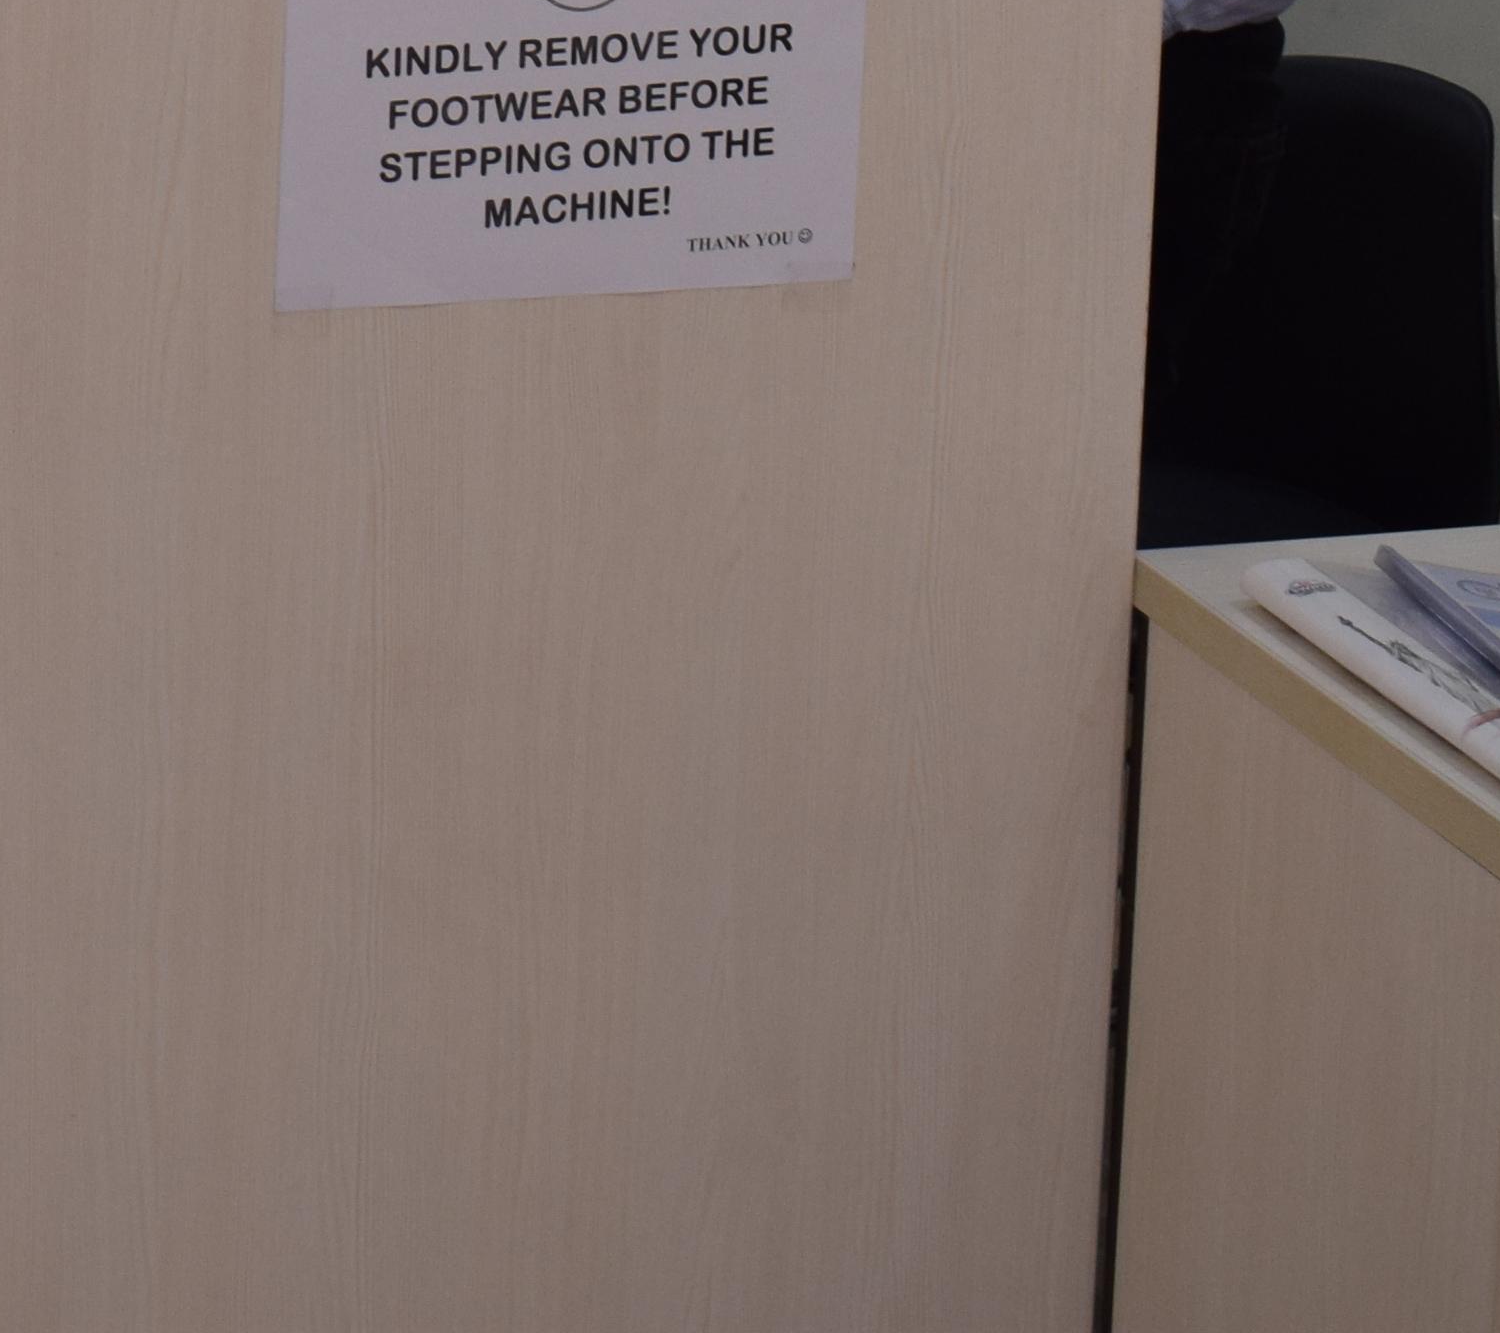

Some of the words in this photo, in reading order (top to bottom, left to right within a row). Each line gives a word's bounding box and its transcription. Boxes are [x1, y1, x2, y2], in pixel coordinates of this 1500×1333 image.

[365, 40, 508, 79] KINDLY
[518, 29, 679, 69] REMOVE
[689, 21, 795, 56] YOUR
[388, 85, 608, 130] FOOTWEAR
[618, 75, 770, 112] BEFORE
[378, 139, 571, 184] STEPPING
[583, 131, 691, 170] ONTO
[701, 126, 775, 159] THE
[483, 186, 672, 230] MACHINE!
[686, 233, 751, 253] THANK
[756, 229, 795, 249] YOU
